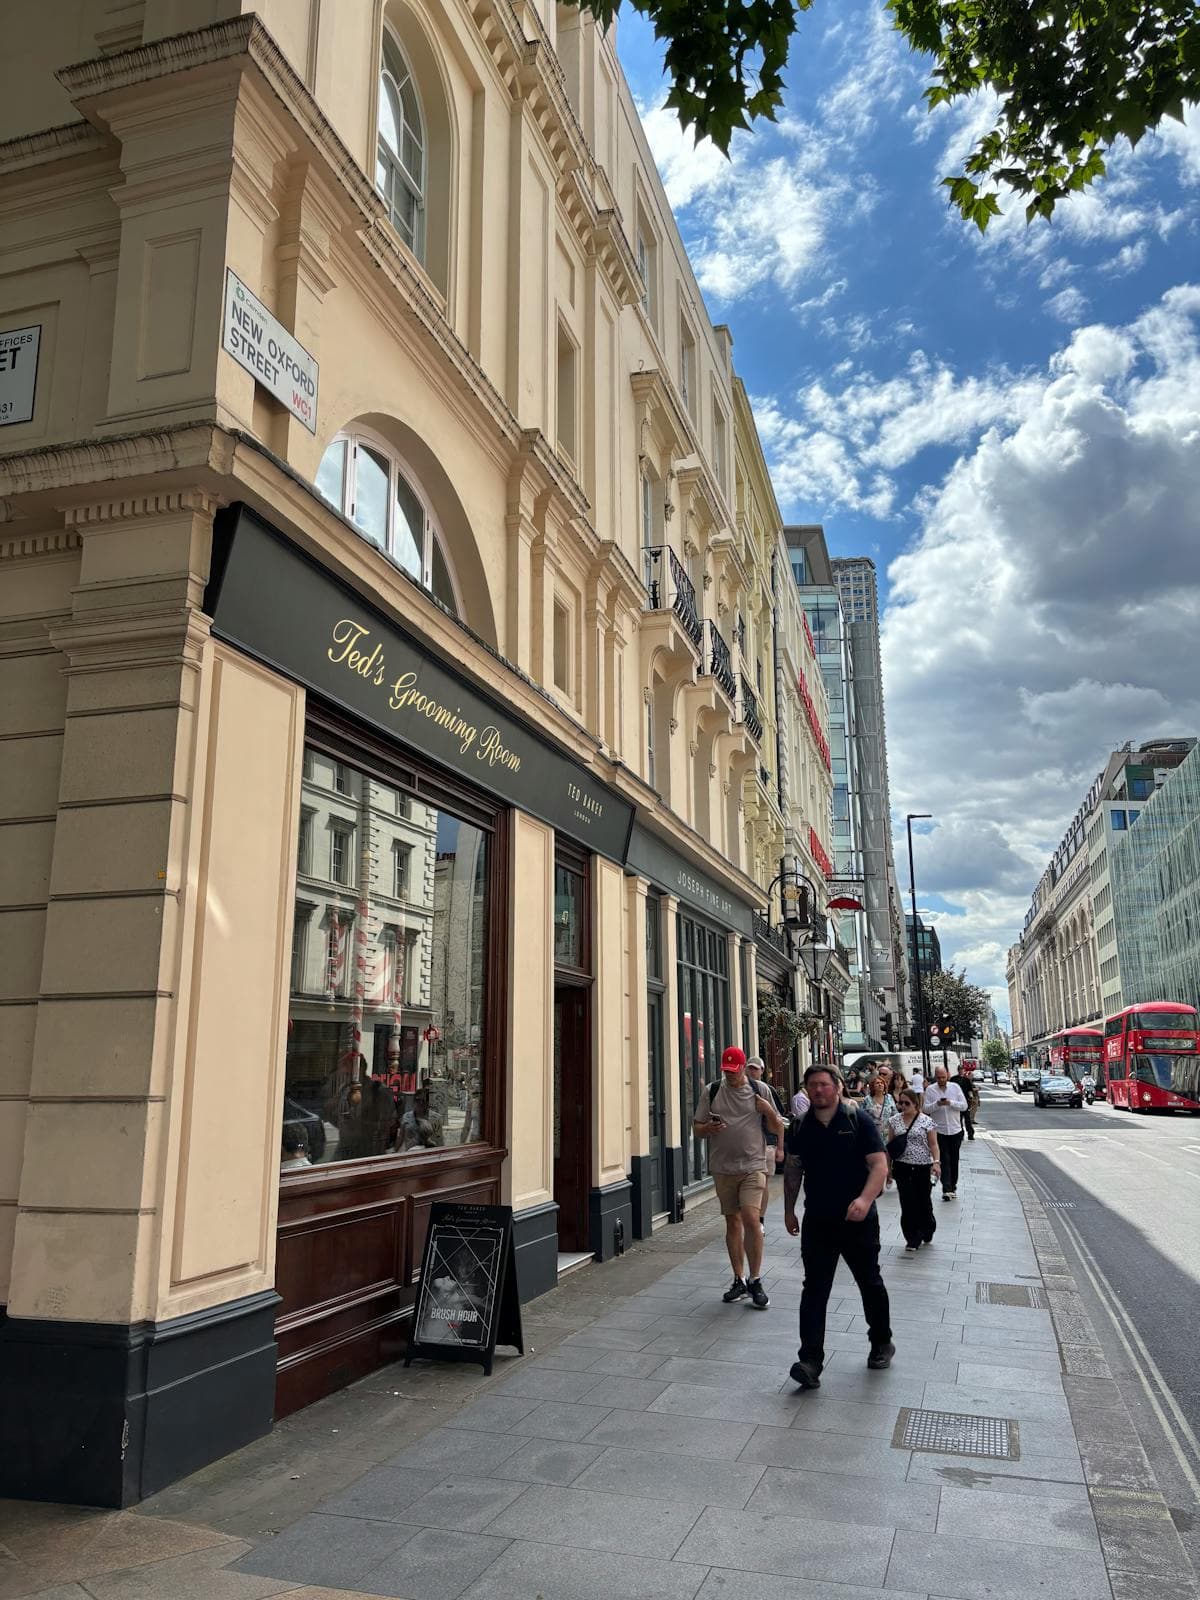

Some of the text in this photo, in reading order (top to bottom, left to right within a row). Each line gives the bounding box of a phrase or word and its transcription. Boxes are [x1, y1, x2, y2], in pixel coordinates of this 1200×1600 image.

[245, 298, 268, 325] Camden
[230, 327, 280, 385] STREET
[232, 301, 315, 397] NEW OXFORD
[292, 390, 312, 419] WC1
[328, 620, 520, 772] Ted's Grooming Room
[567, 783, 602, 816] TED BAKER
[678, 871, 732, 916] JOSEPH FINE ART
[1182, 1040, 1193, 1048] 38
[431, 1307, 478, 1323] BRUSH HOUR
